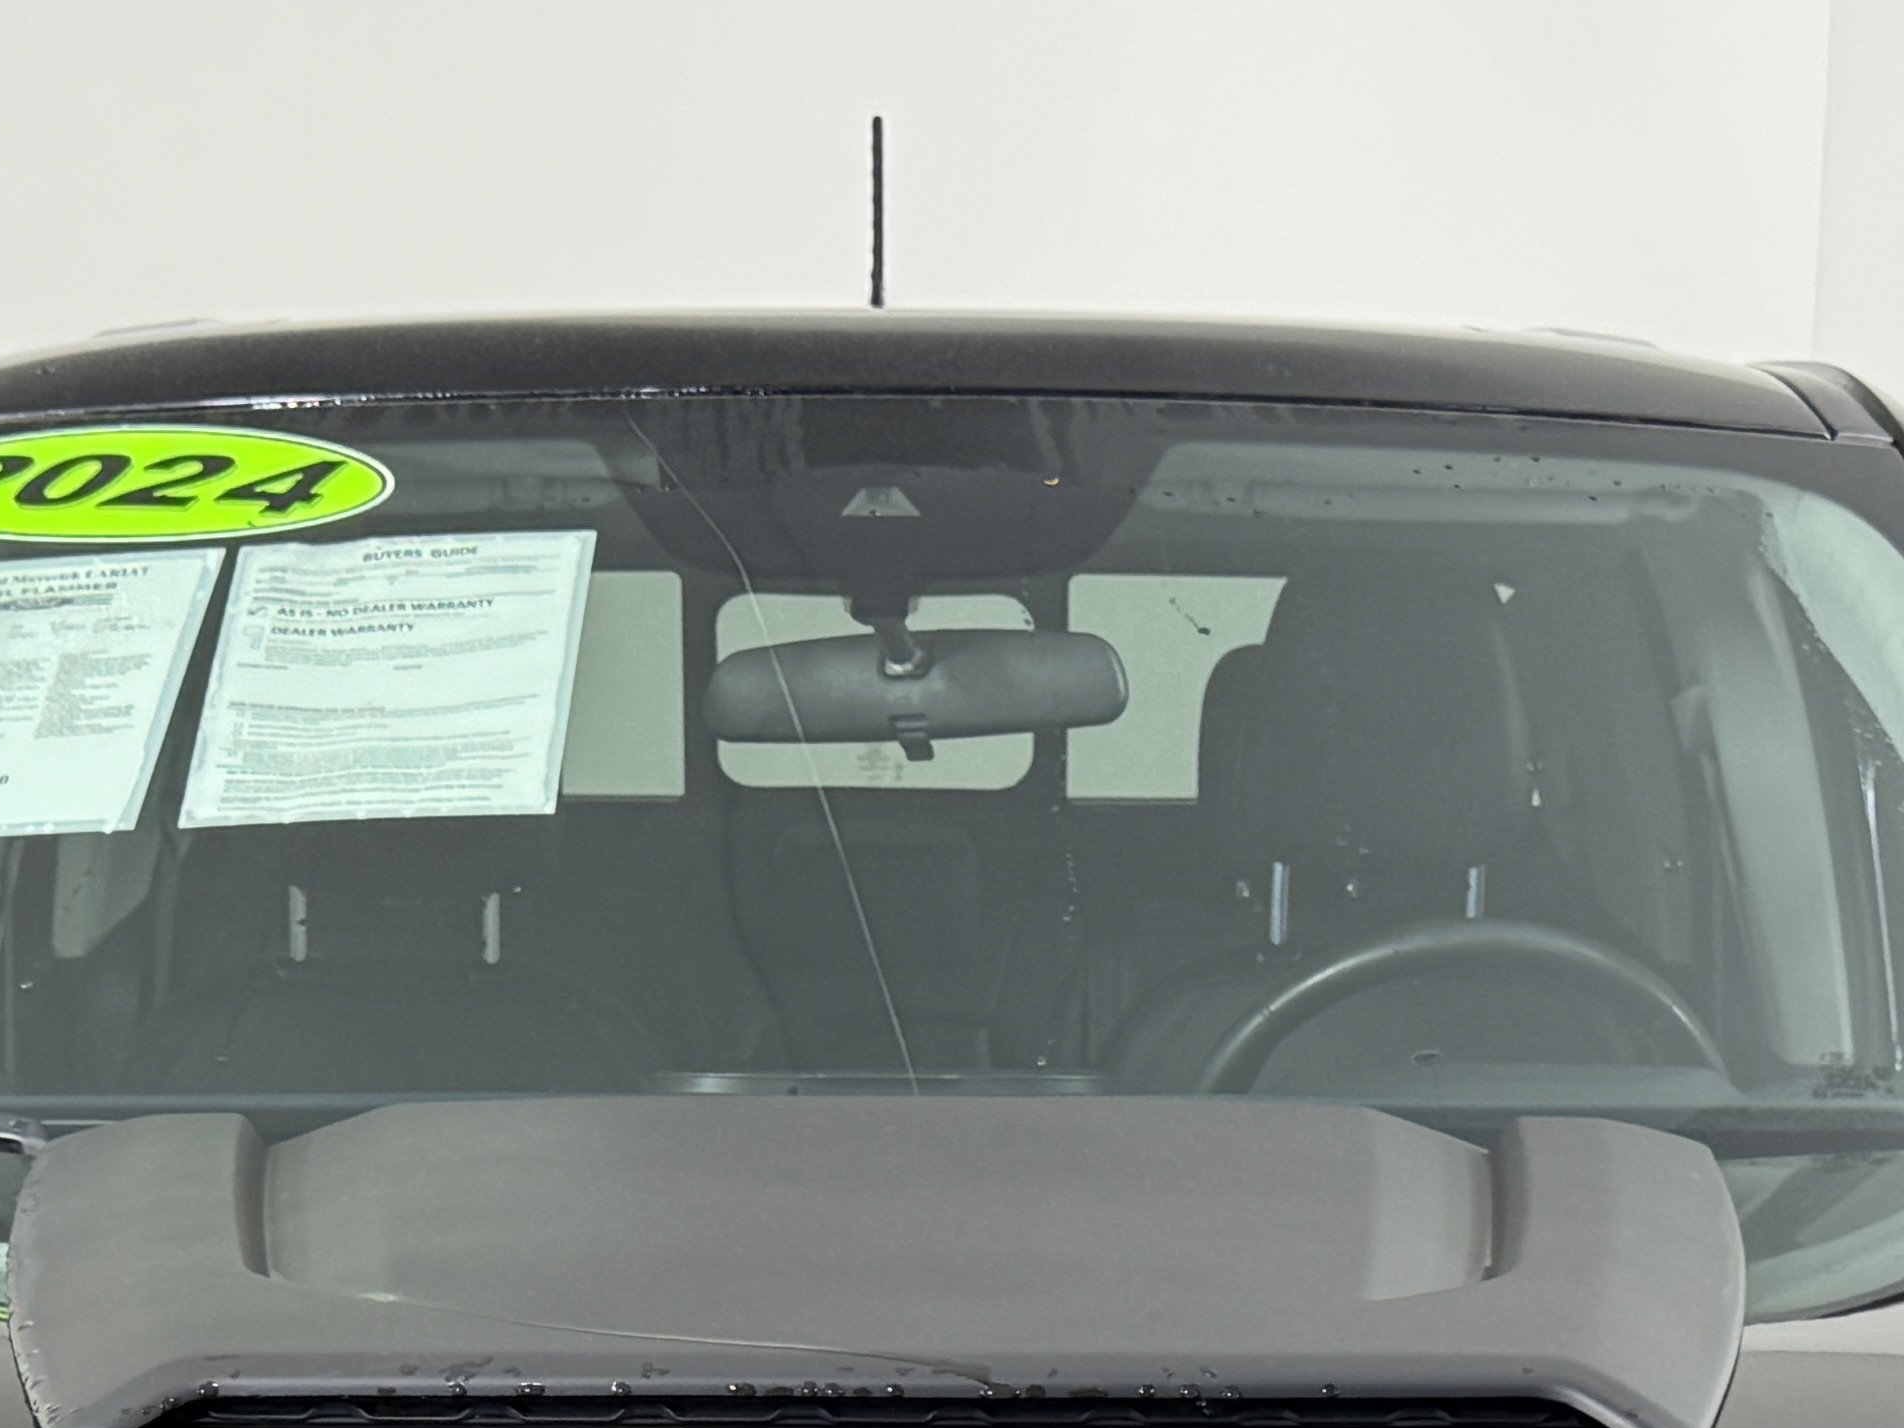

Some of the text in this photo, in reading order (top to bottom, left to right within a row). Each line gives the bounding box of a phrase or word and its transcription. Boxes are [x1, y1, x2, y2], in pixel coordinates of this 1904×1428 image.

[362, 545, 479, 562] BUYERS GUIDE
[277, 606, 296, 617] AS
[299, 606, 313, 617] IS
[326, 606, 349, 617] NO
[352, 602, 407, 615] DEALER
[410, 599, 495, 612] WARRANTY
[270, 622, 415, 637] DEALER WARRANTY
